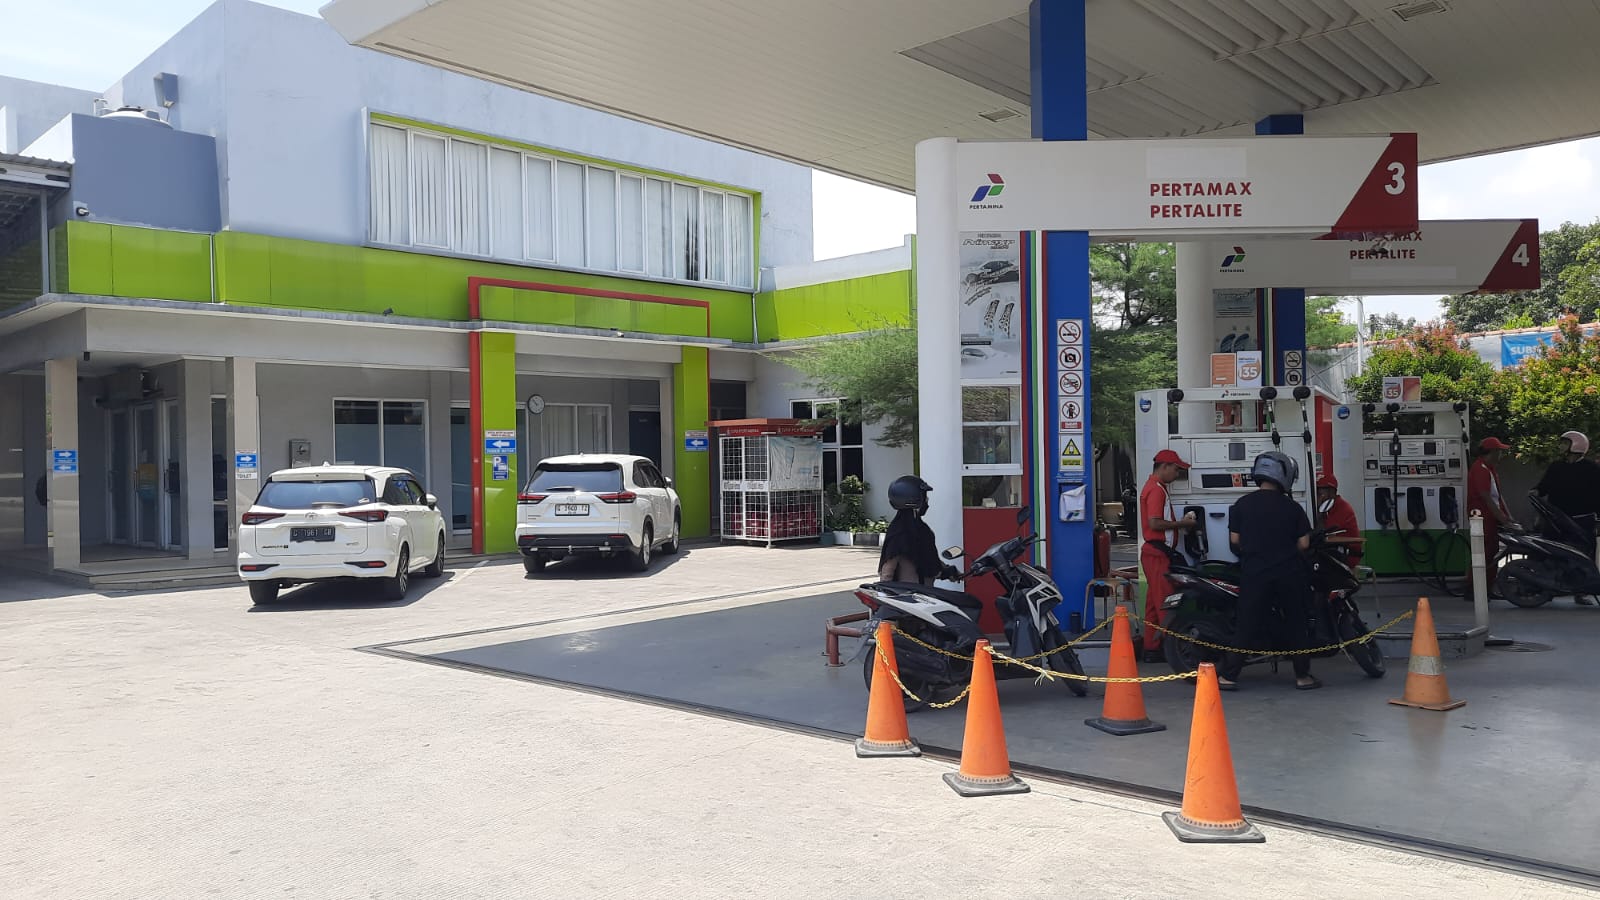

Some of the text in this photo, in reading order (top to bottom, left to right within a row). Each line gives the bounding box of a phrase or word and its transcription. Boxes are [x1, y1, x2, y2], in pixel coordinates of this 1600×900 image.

[1384, 161, 1406, 196] 3
[1150, 181, 1253, 197] PERTAMAX
[1150, 203, 1243, 218] PERTALITE
[1511, 243, 1530, 267] 4
